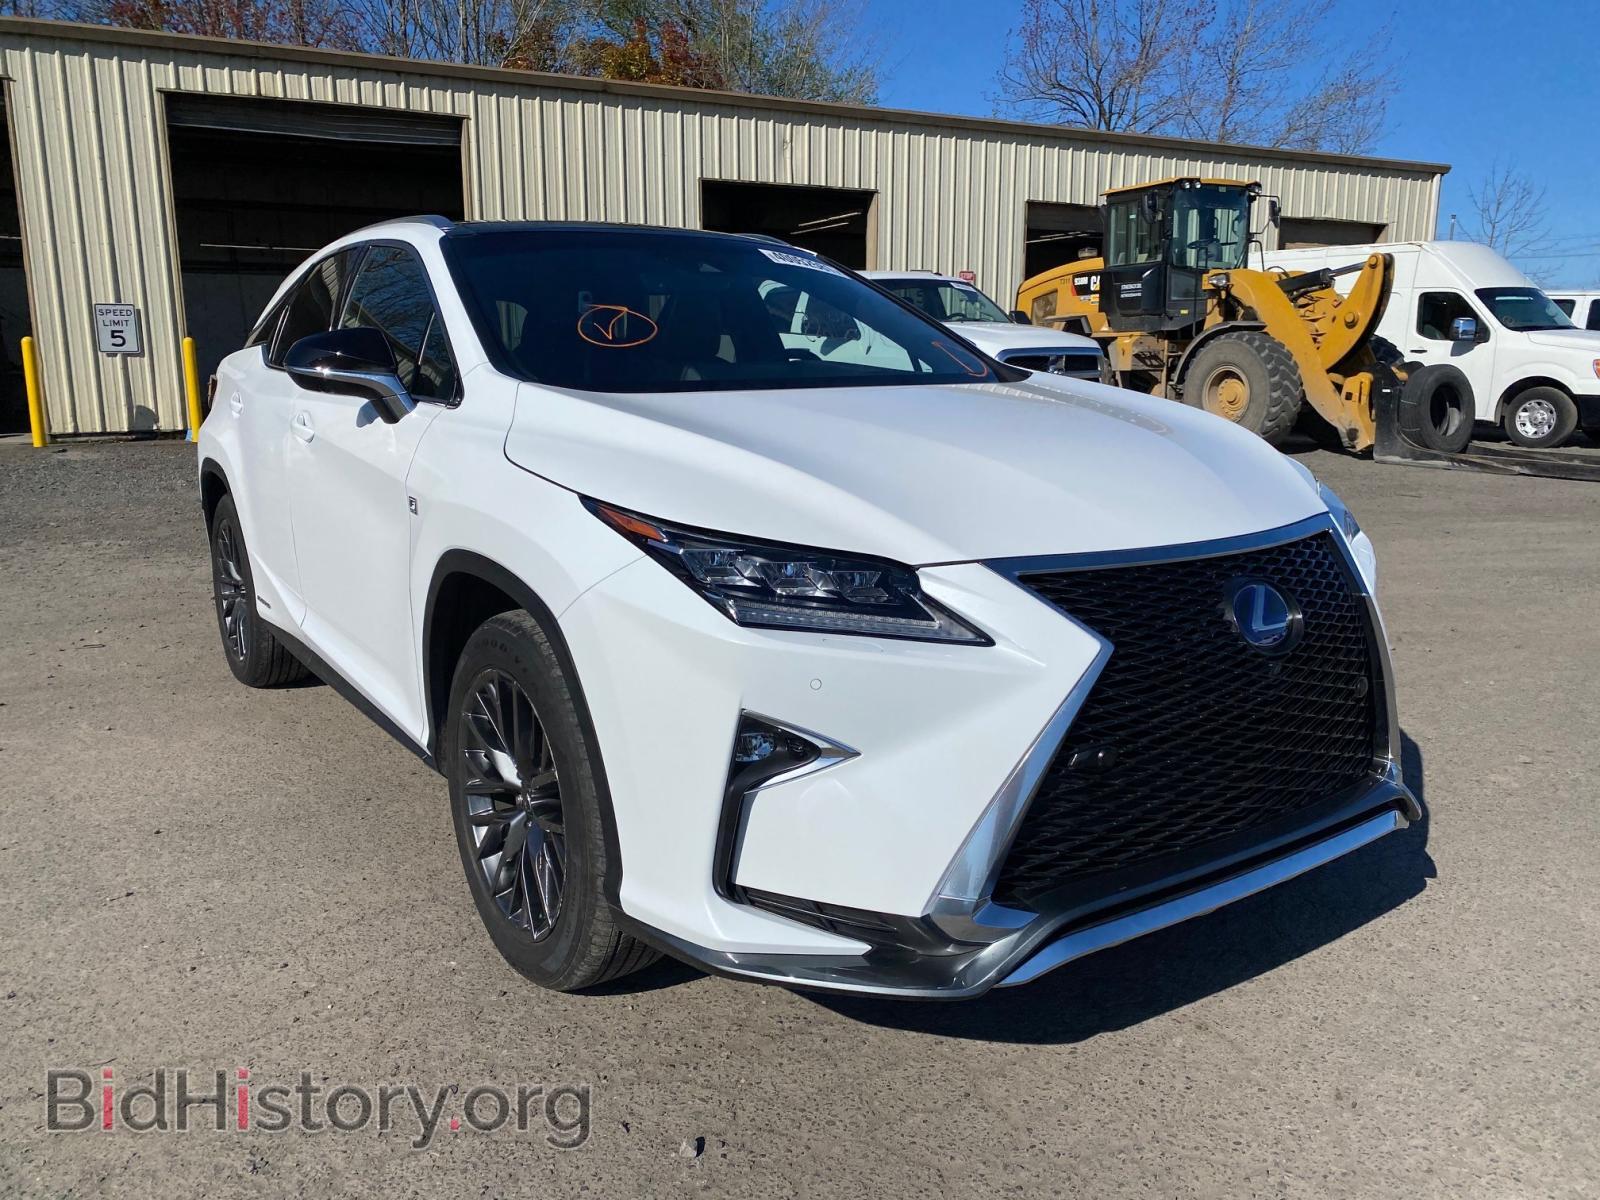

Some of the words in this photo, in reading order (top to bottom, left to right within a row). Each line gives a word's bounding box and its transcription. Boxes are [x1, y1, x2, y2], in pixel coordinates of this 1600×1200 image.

[98, 309, 133, 317] SPEED
[102, 319, 130, 327] LIMIT
[110, 329, 127, 348] 5
